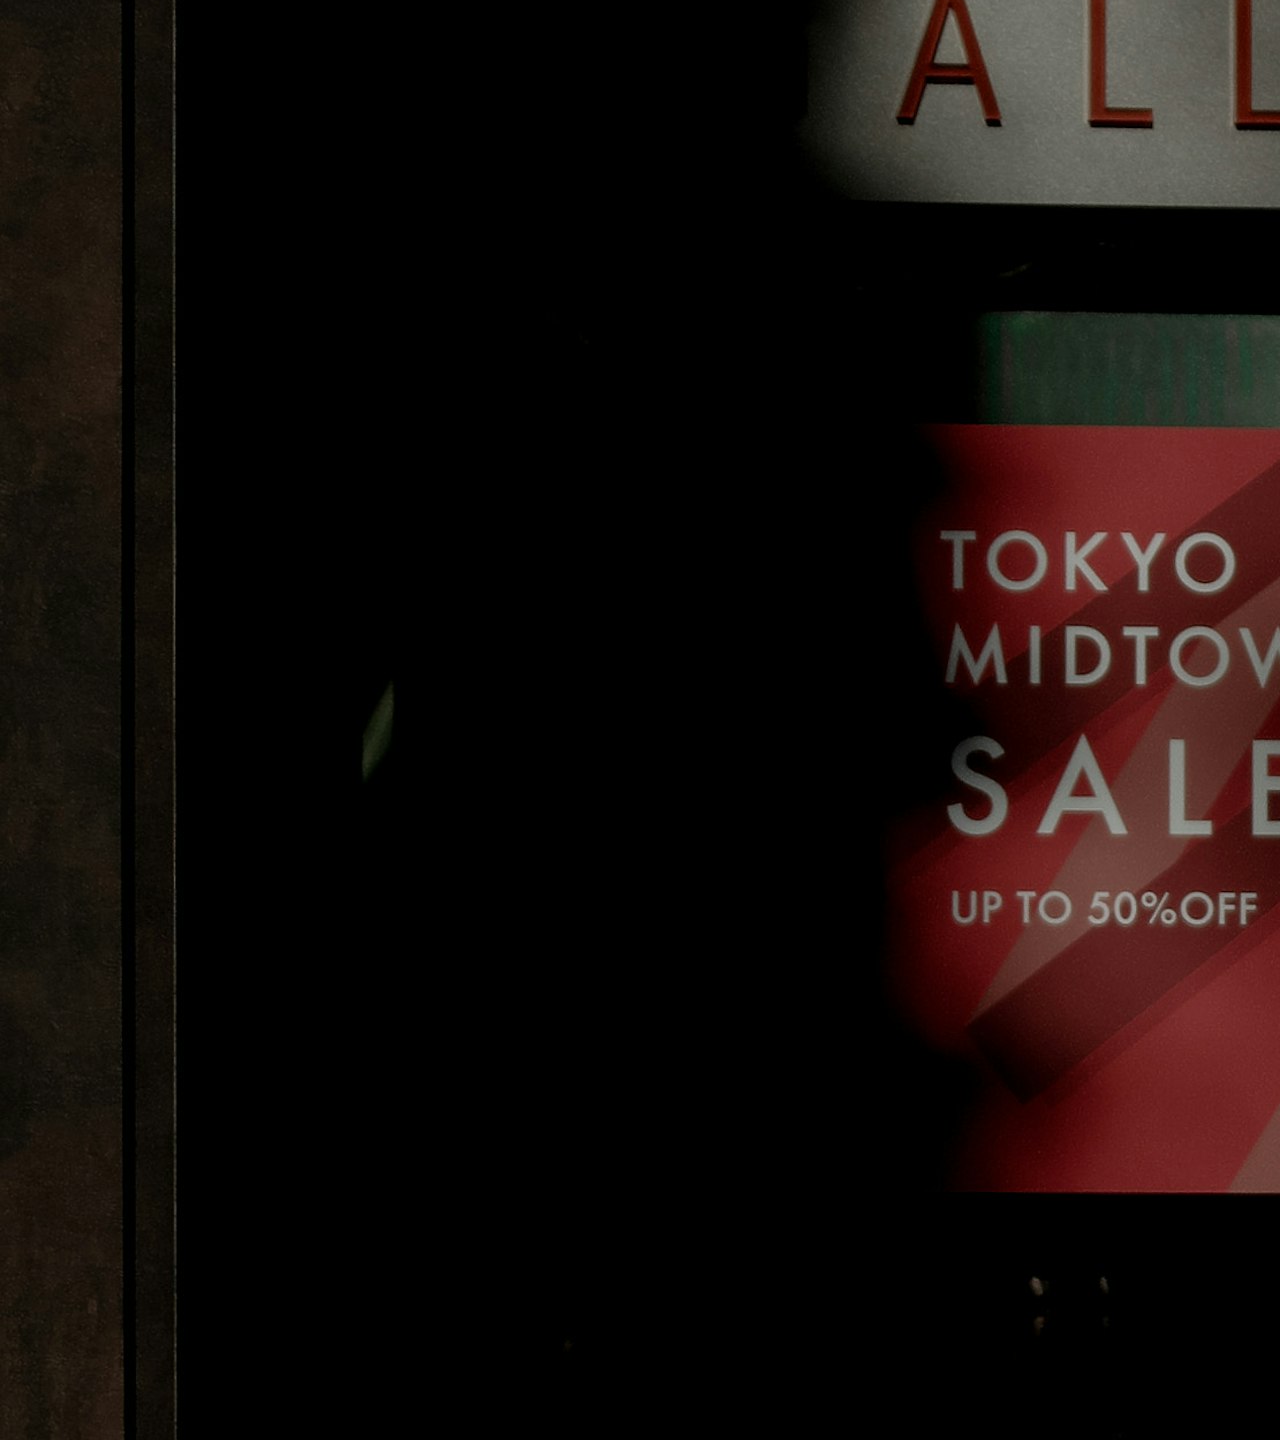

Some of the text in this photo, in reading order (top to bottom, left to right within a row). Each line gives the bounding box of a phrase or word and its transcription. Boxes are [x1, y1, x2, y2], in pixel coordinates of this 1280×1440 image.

[940, 528, 1237, 594] TOKYO
[951, 891, 1260, 928] UP TO 50%OFF
